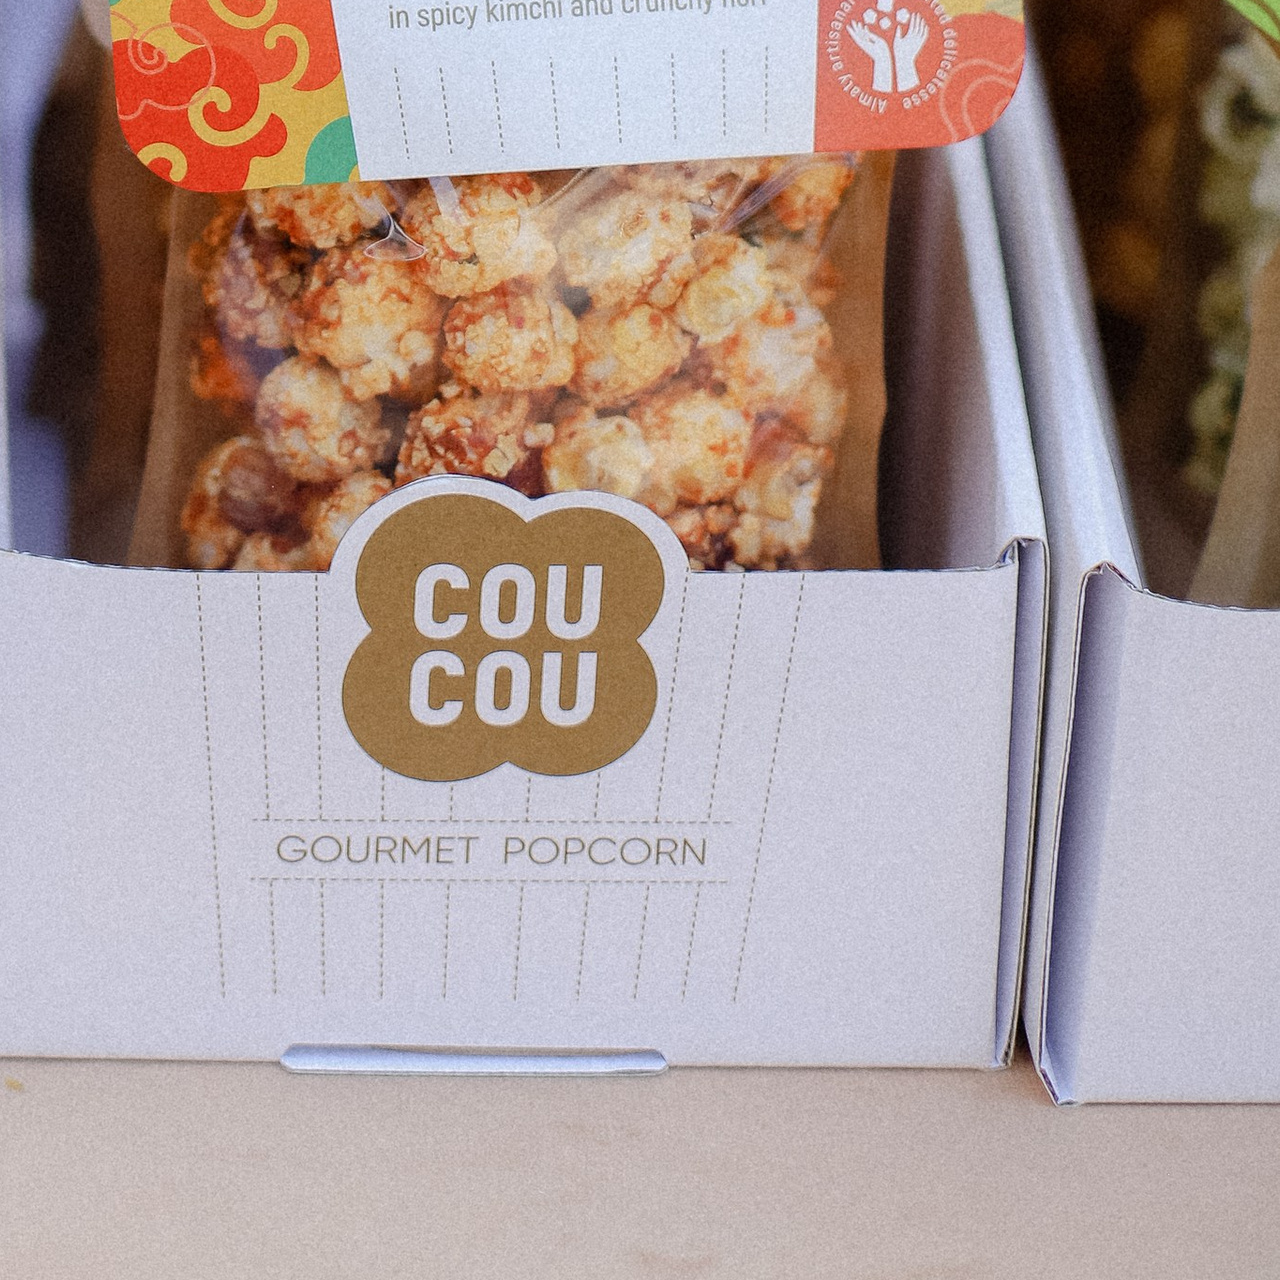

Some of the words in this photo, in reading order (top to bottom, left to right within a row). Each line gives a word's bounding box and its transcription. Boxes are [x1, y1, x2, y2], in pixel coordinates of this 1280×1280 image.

[389, 5, 410, 29] in
[417, 1, 478, 32] spicy
[837, 73, 888, 114] Almaty
[414, 562, 603, 641] COU
[408, 650, 597, 729] COU
[276, 835, 480, 867] GOURMET
[502, 836, 708, 867] POPCORN
